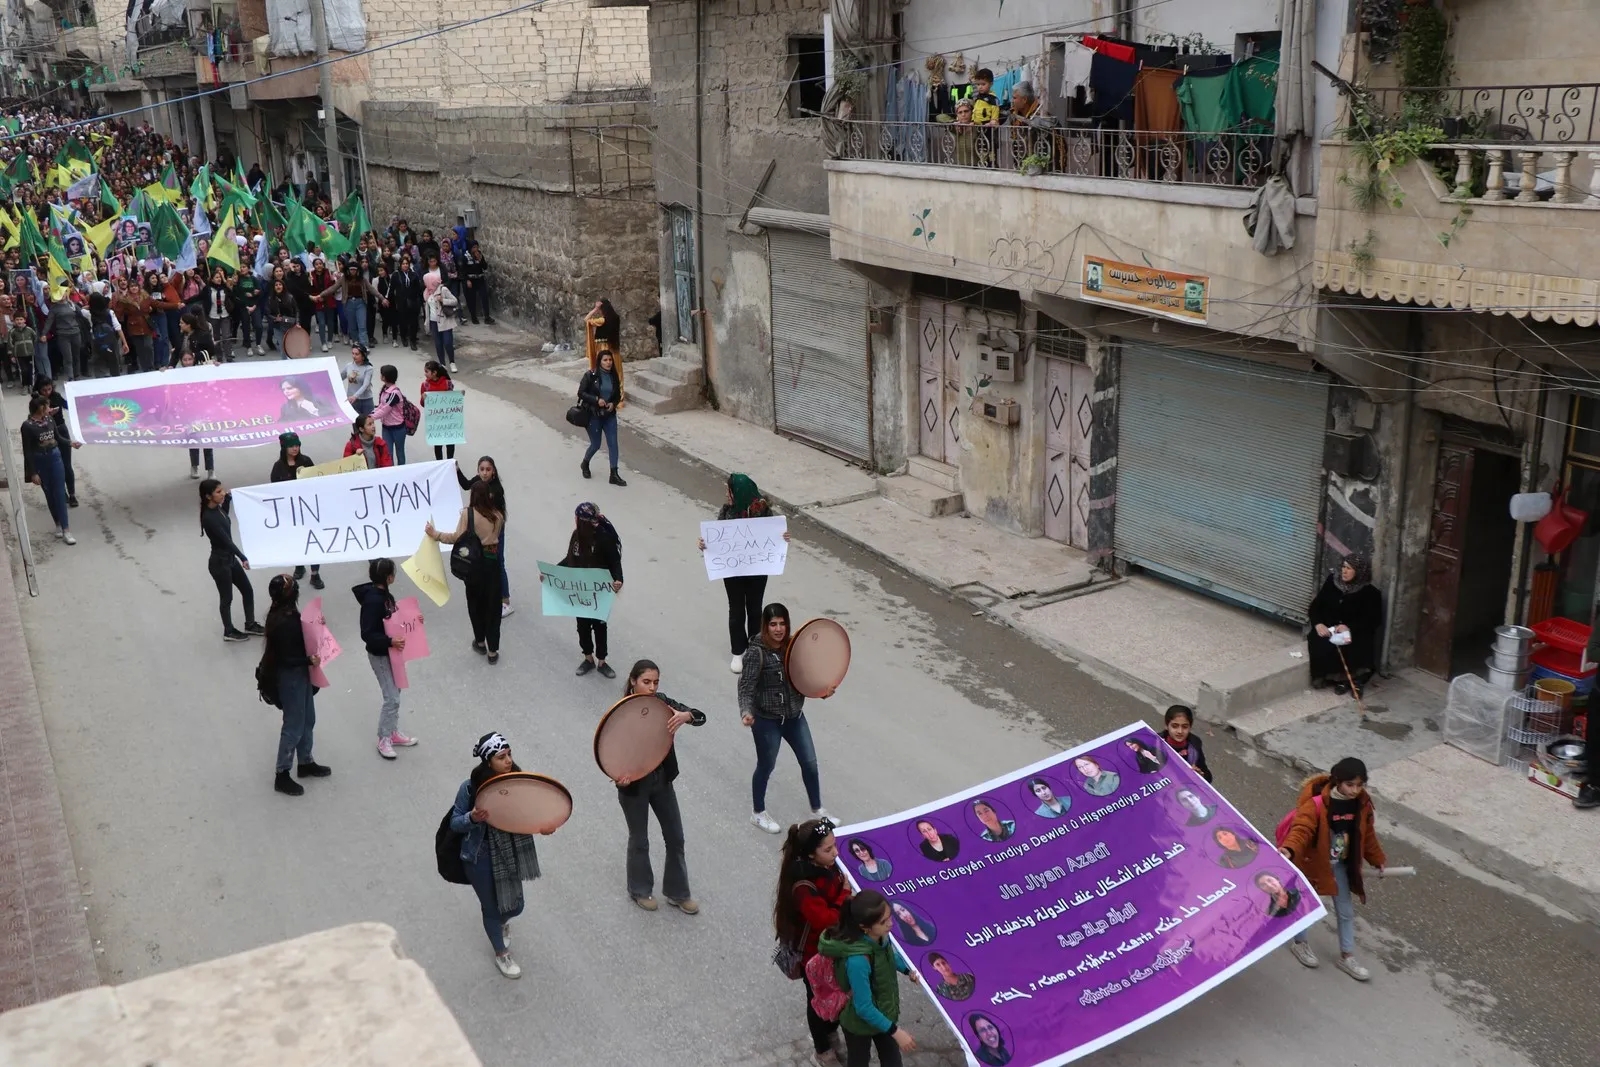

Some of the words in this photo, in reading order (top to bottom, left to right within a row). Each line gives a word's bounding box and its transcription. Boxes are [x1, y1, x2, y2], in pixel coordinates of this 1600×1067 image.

[107, 428, 156, 438] ROJA
[161, 424, 186, 436] 25
[200, 429, 281, 444] DERKETINA
[262, 494, 321, 529] JIN
[349, 479, 432, 520] JIYAN
[304, 518, 392, 555] AZADÎ
[706, 525, 754, 544] DEM
[718, 536, 776, 556] DEMA
[882, 884, 896, 896] Li
[916, 875, 938, 888] Her
[939, 860, 986, 881] Cûreyên
[984, 841, 1031, 865] Tundiya
[1030, 824, 1071, 848] Dewlet
[1070, 819, 1080, 830] û
[1079, 792, 1141, 826] Hişmendiya
[1139, 776, 1172, 797] Zilam
[1163, 842, 1186, 860] ضد
[999, 883, 1024, 900] Jin
[1024, 865, 1067, 890] Jiyan
[1066, 841, 1111, 873] Azadî
[1132, 853, 1164, 876] كافة
[1070, 890, 1095, 906] عنف
[1033, 898, 1070, 922] الدولة
[993, 915, 1036, 936] وذهنية
[1081, 919, 1110, 937] حياة
[965, 926, 995, 947] الرجل
